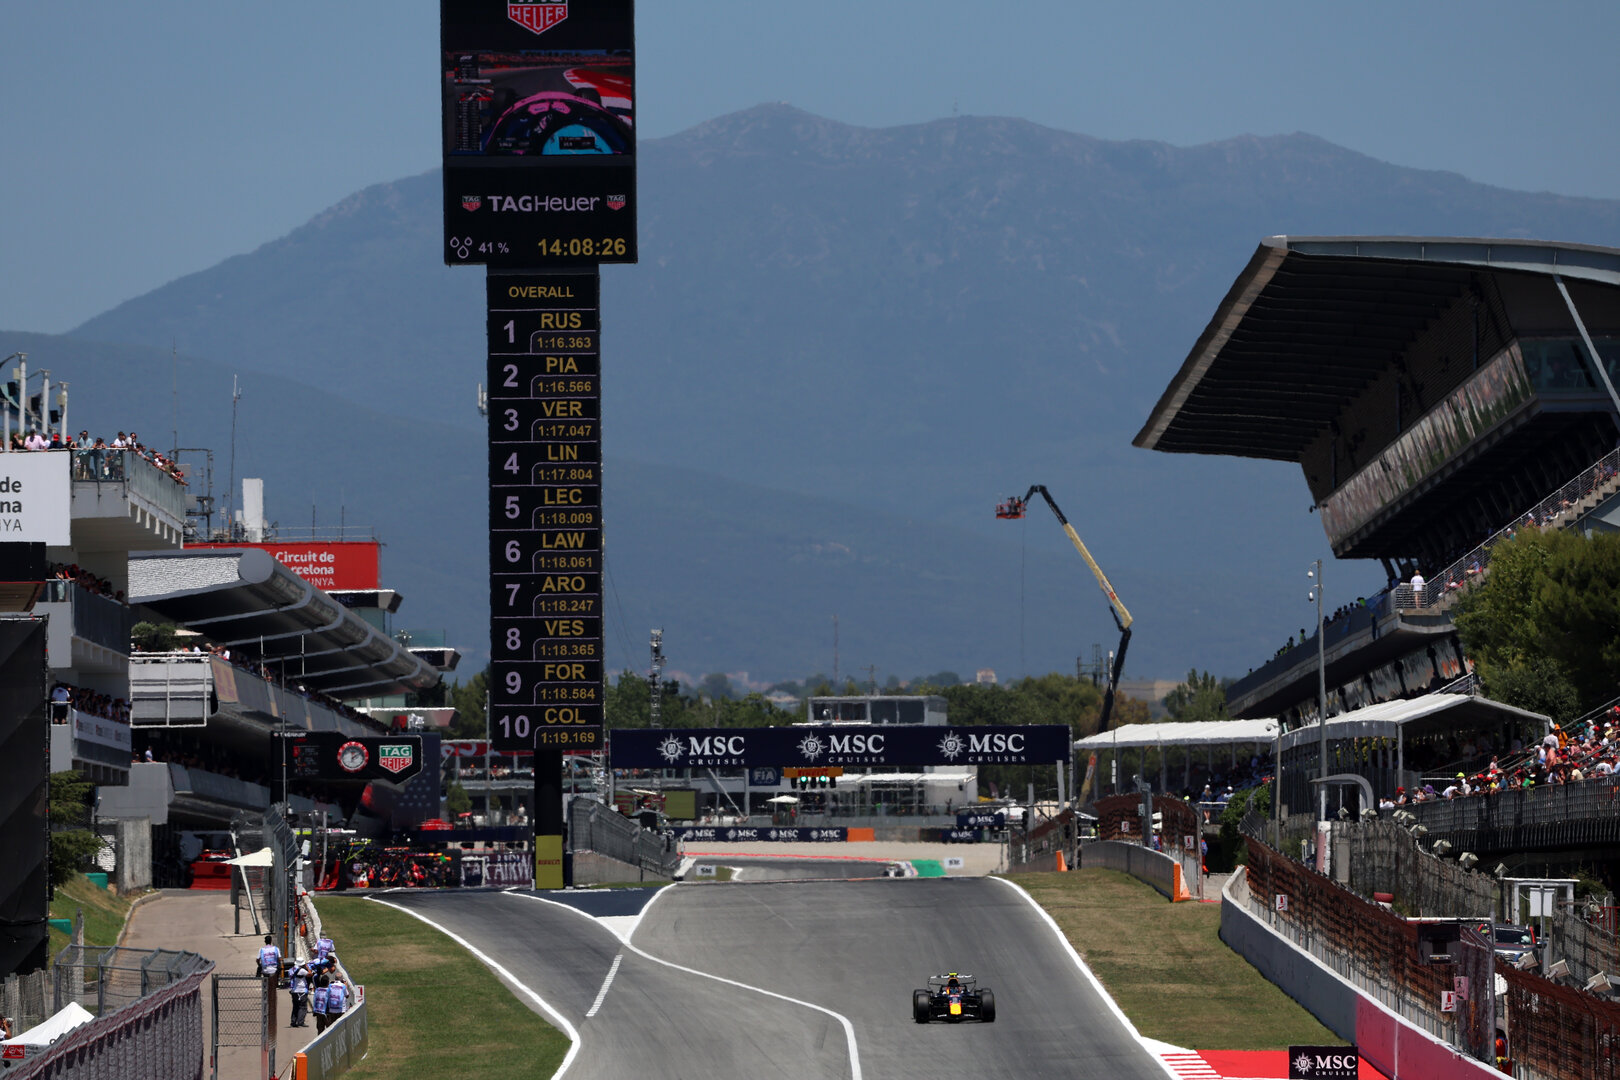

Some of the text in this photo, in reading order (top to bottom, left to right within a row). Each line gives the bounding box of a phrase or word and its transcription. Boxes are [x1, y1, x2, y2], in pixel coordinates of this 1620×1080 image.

[511, 7, 565, 31] HEUER
[463, 195, 481, 203] TAG
[487, 195, 601, 212] TAGHeuer
[607, 195, 626, 203] TAG
[478, 241, 510, 254] 41 %
[537, 237, 626, 256] 14:08:26
[508, 286, 575, 298] OVERALL
[503, 312, 582, 344] 1 RUS
[537, 336, 592, 349] 1:16.363
[503, 356, 579, 388] 2 PIA
[538, 380, 592, 393] 1:16.566
[503, 400, 583, 432] 3 VER
[538, 424, 592, 437] 1:17.047
[503, 444, 578, 475] 4 LIN
[538, 468, 593, 481] 1:17.804
[0, 476, 22, 493] de
[505, 488, 583, 520] 5 LEC
[539, 512, 593, 525] 1:18.009
[505, 532, 585, 563] 6 LAW
[275, 551, 335, 563] Circuit de
[539, 556, 593, 569] 1:18.061
[505, 575, 586, 607] 7 ARO
[539, 599, 594, 612] 1:18.247
[505, 619, 585, 651] 8 VES
[540, 643, 595, 657] 1:18.365
[505, 663, 586, 695] 9 FOR
[540, 687, 595, 701] 1:18.584
[498, 707, 586, 739] 10 COL
[540, 732, 595, 745] 1:19.169
[828, 734, 885, 754] MSC
[968, 733, 1025, 753] MSC
[382, 747, 410, 756] TAG
[688, 736, 745, 756] MSC
[381, 757, 411, 771] HEUER
[688, 758, 745, 766] CRUISES
[828, 756, 885, 764] CRUISES
[968, 755, 1026, 763] CRUISES
[754, 769, 775, 781] FIA
[976, 815, 995, 823] MSC
[694, 828, 716, 838] MSC
[737, 829, 758, 838] MSC
[778, 829, 799, 839] MSC
[820, 829, 841, 838] MSC
[1315, 1055, 1356, 1070] MSC
